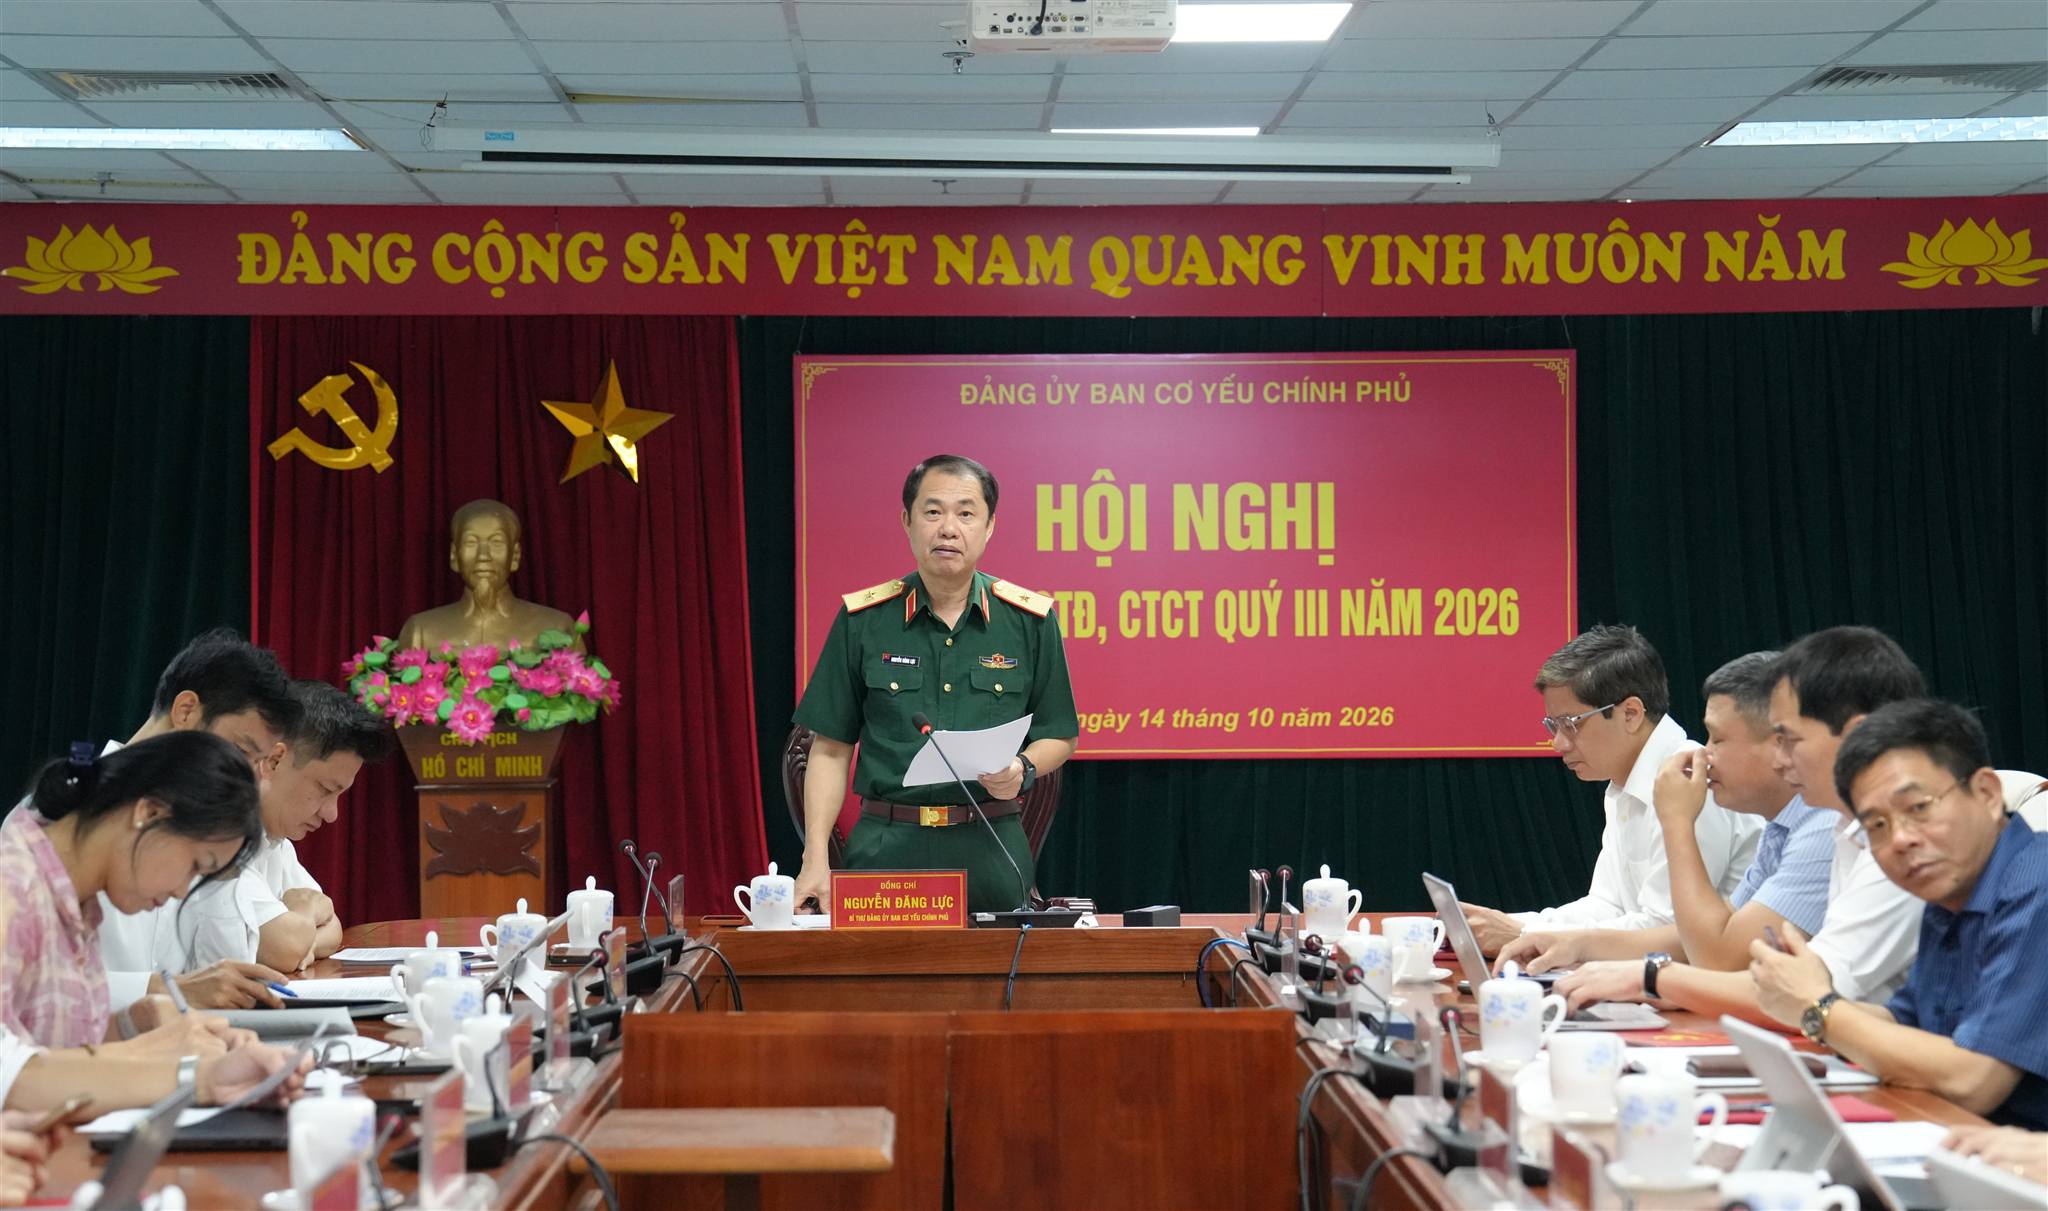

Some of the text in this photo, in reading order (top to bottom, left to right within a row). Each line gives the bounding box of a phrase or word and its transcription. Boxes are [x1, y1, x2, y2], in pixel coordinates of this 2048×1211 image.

[237, 210, 1847, 299] ĐẢNG CỘNG SẢN VIỆT NAM QUANG VINH MUÔN NĂM
[960, 371, 1411, 405] ĐẢNG ỦY BAN CƠ YẾU CHÍNH PHỦ
[1036, 469, 1335, 567] HỘI NGHỊ
[1036, 578, 1520, 645] TĐ, CTCT QUÝ III NĂM 2026
[1139, 708, 1165, 728] 14
[1172, 707, 1240, 733] tháng
[1248, 707, 1275, 728] 10
[1281, 705, 1332, 727] năm
[1340, 706, 1394, 727] 2026
[456, 753, 485, 777] CHÍ
[495, 755, 543, 777] MINH
[880, 880, 917, 890] ĐỒNG CHÍ
[843, 893, 954, 910] NGUYỄN ĐĂNG LỰC
